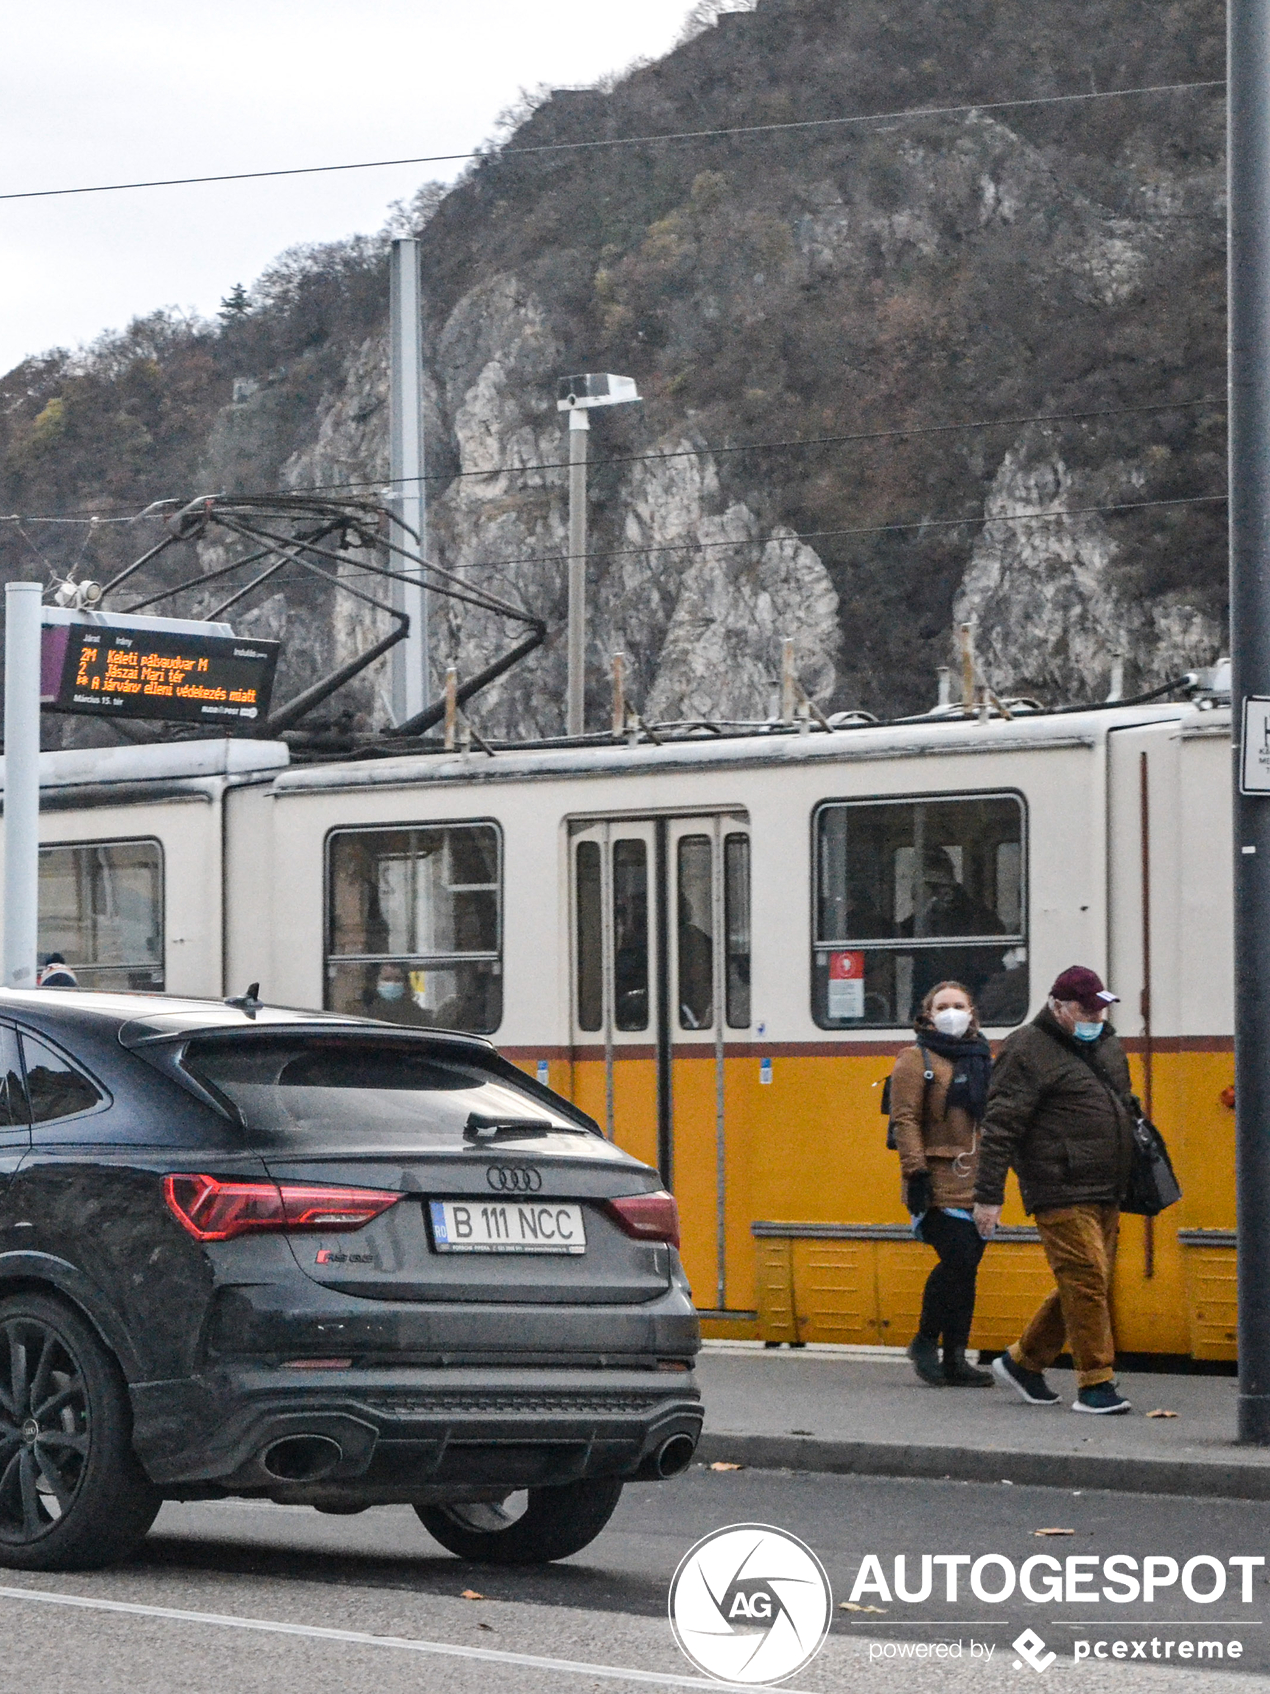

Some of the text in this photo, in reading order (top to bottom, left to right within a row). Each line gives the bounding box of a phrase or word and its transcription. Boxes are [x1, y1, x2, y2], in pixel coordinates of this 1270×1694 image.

[80, 647, 98, 662] 2M
[106, 650, 138, 665] Keleti
[197, 658, 209, 671] M
[77, 661, 186, 683] 2 Jászai Mari tér
[73, 694, 124, 706] Március 15. tér
[91, 676, 101, 690] A
[101, 677, 142, 693] járvány
[143, 681, 173, 696] elleni
[176, 684, 227, 700] védekezés
[229, 688, 256, 703] miatt
[435, 1225, 447, 1238] RO
[453, 1206, 573, 1240] B 111 NCC
